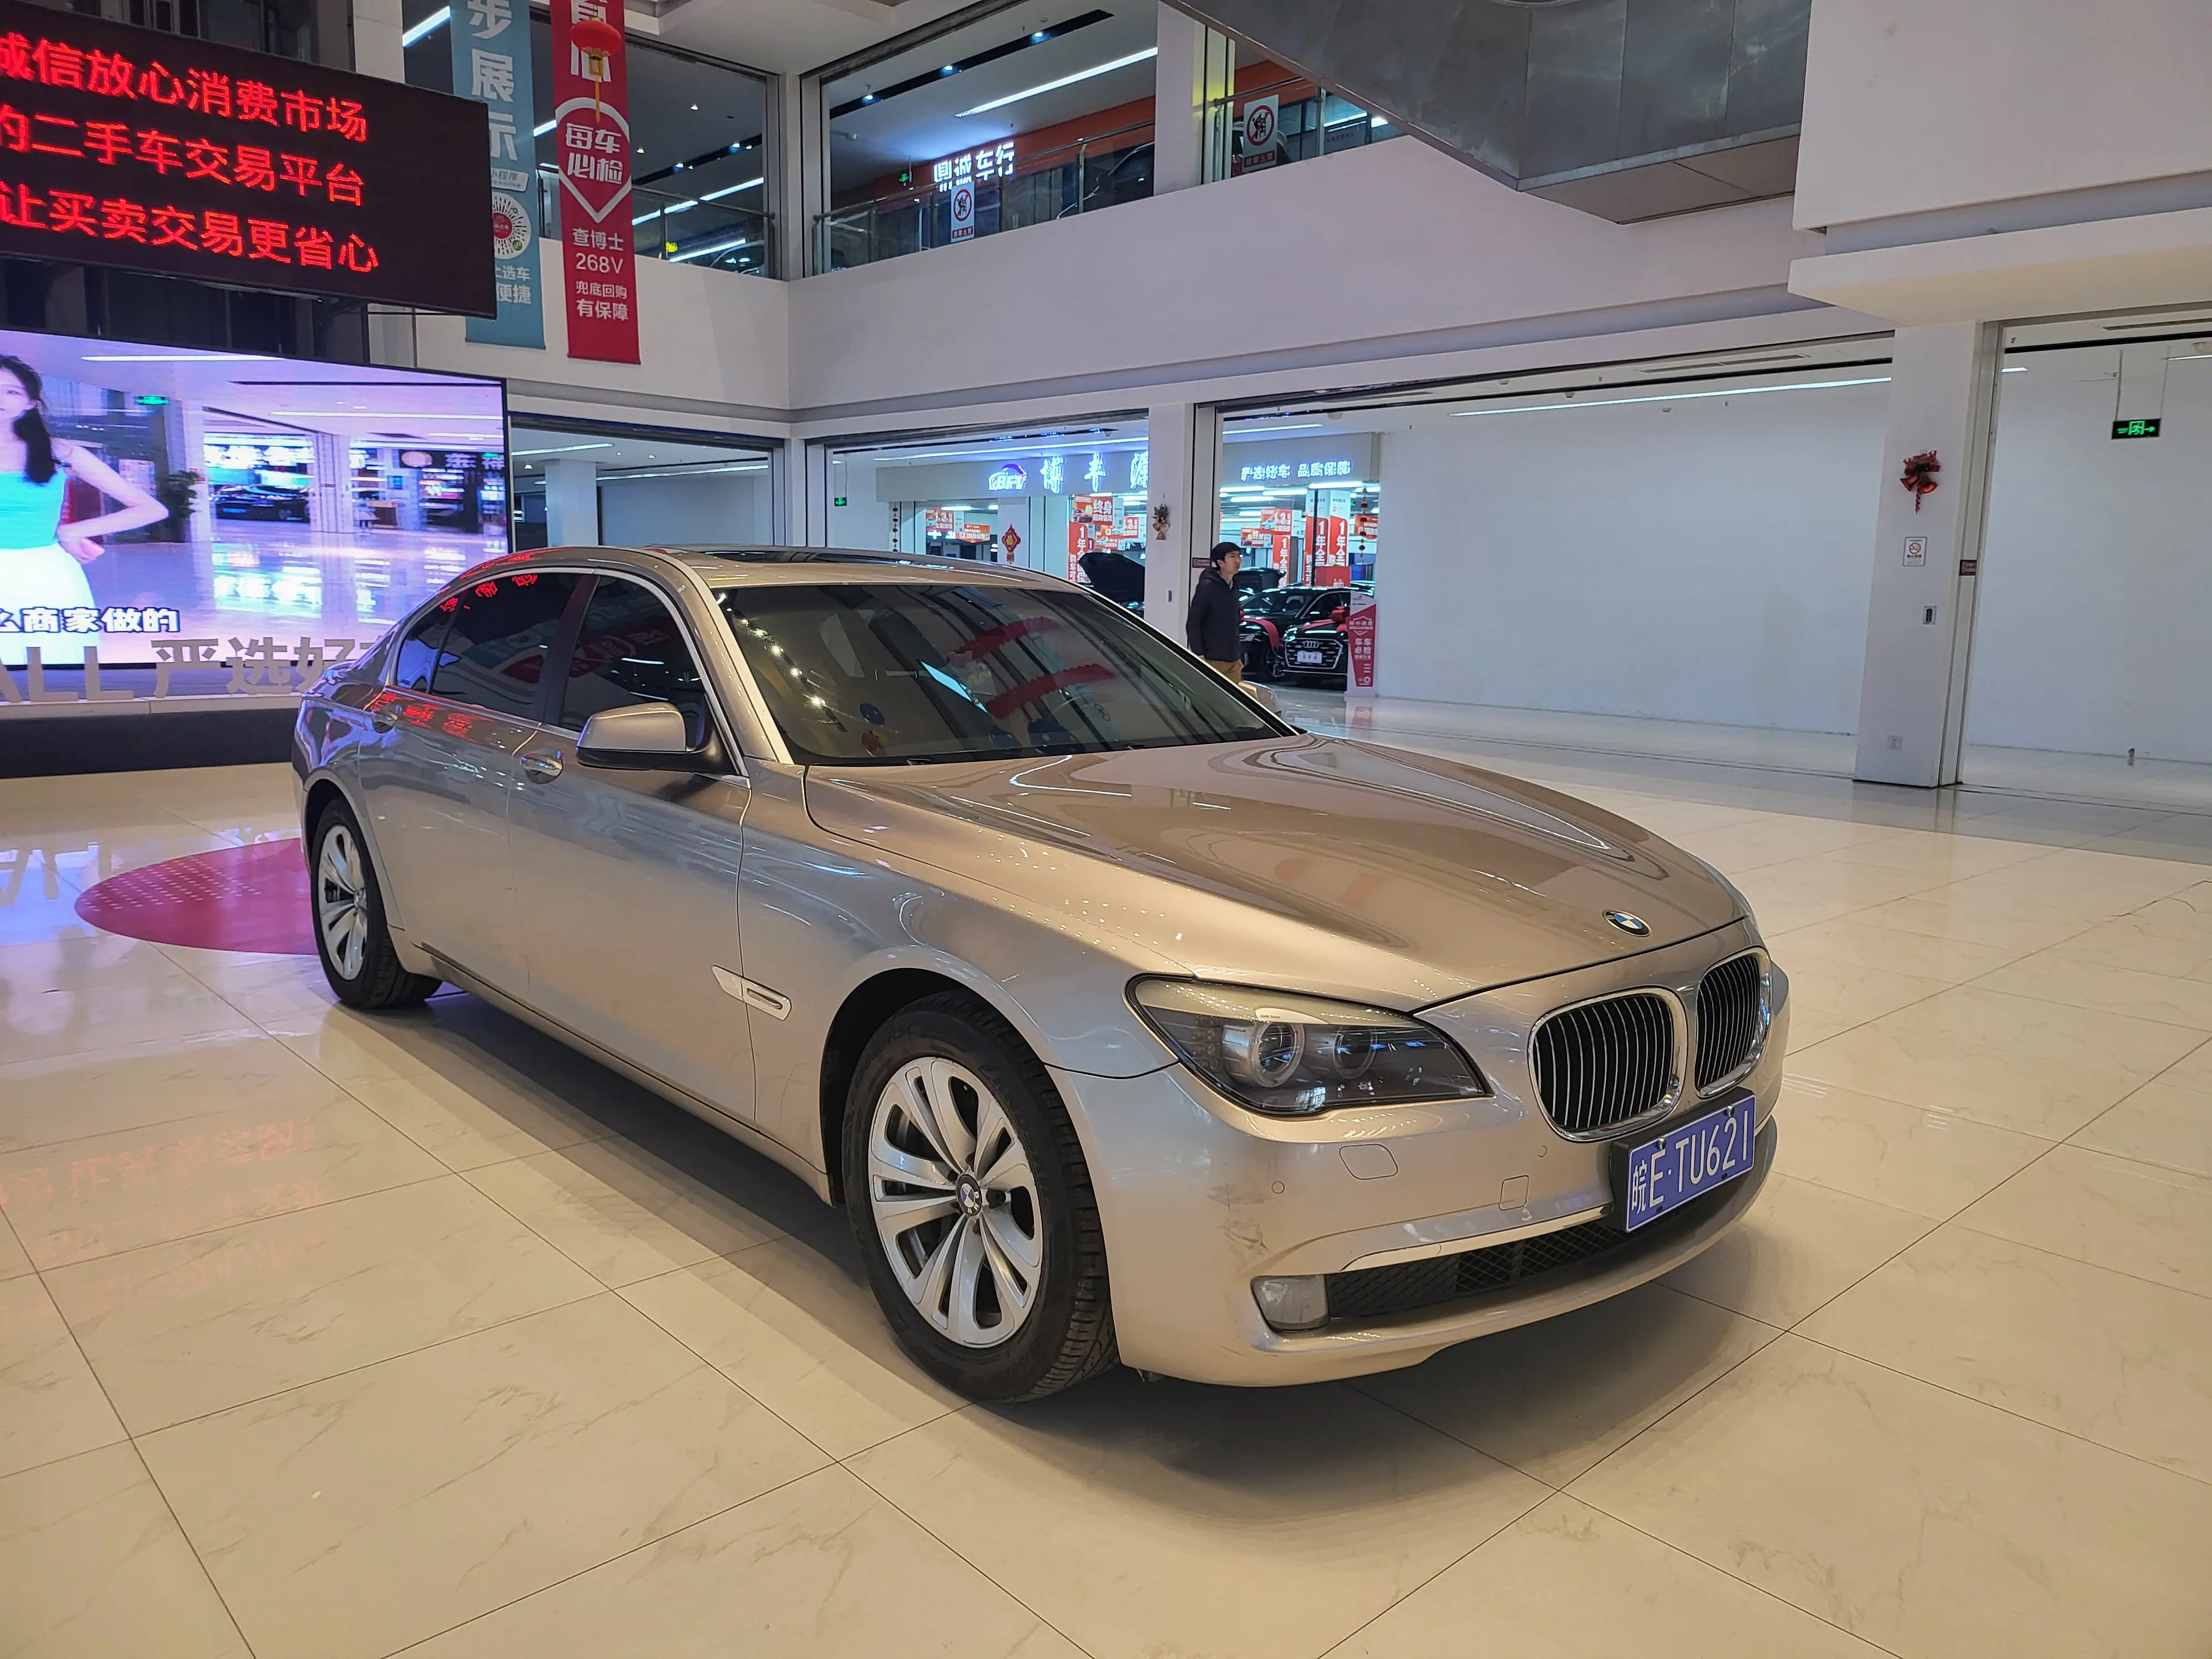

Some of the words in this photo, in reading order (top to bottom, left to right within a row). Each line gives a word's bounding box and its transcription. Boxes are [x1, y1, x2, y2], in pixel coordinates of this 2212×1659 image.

[566, 123, 622, 154] 每车
[567, 152, 624, 185] 必检
[0, 181, 378, 273] 让买卖交易更省心
[572, 228, 624, 251] 查博士
[576, 253, 623, 274] 268V
[576, 280, 628, 299] 兜底回购
[576, 299, 629, 321] 有保障
[1240, 463, 1291, 482] 严选好车
[1298, 460, 1350, 478] 品质保障
